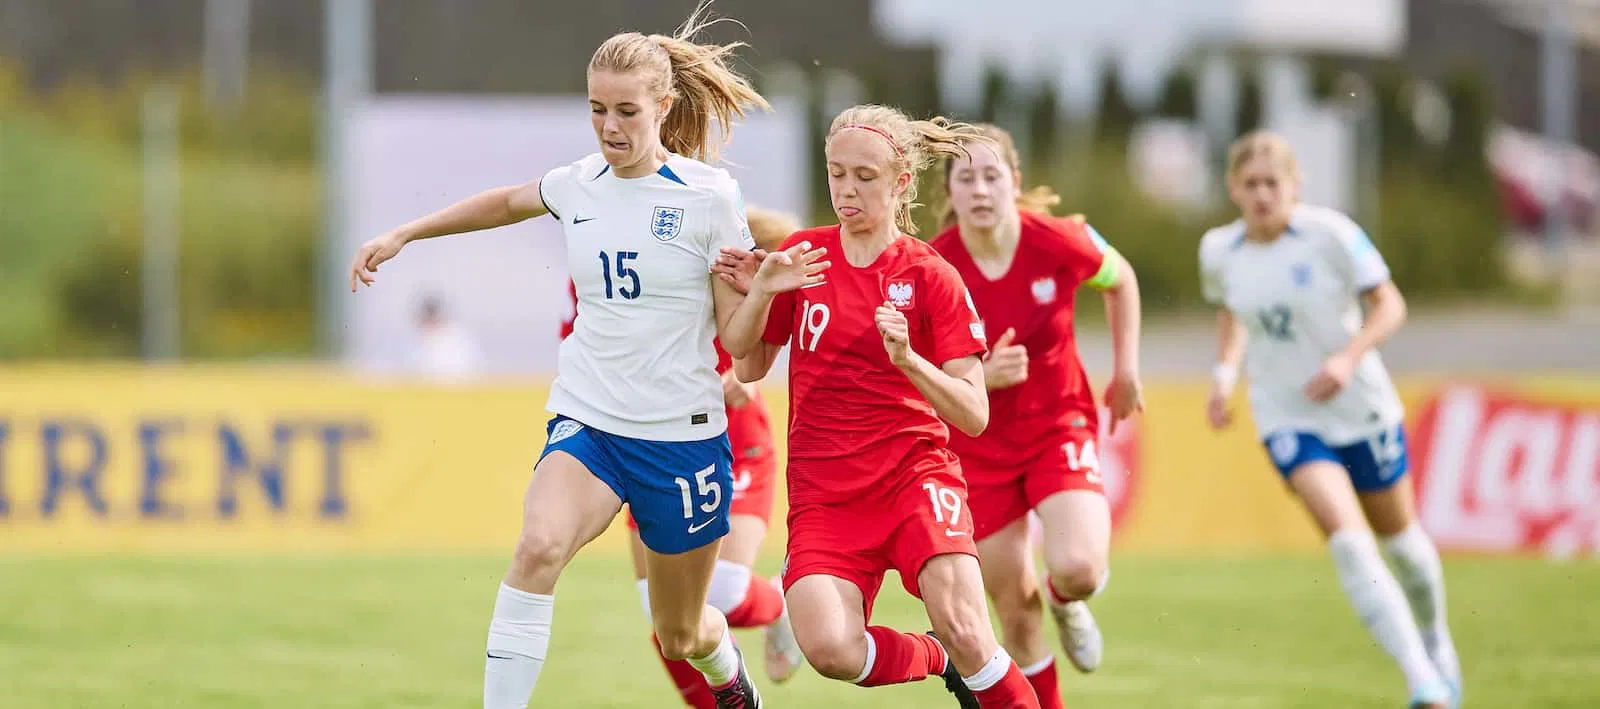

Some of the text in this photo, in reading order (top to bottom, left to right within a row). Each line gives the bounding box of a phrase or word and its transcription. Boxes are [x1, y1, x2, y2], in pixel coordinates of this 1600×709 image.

[599, 250, 641, 300] 15
[799, 299, 830, 352] 19
[674, 463, 722, 519] 15
[923, 482, 962, 525] 19
